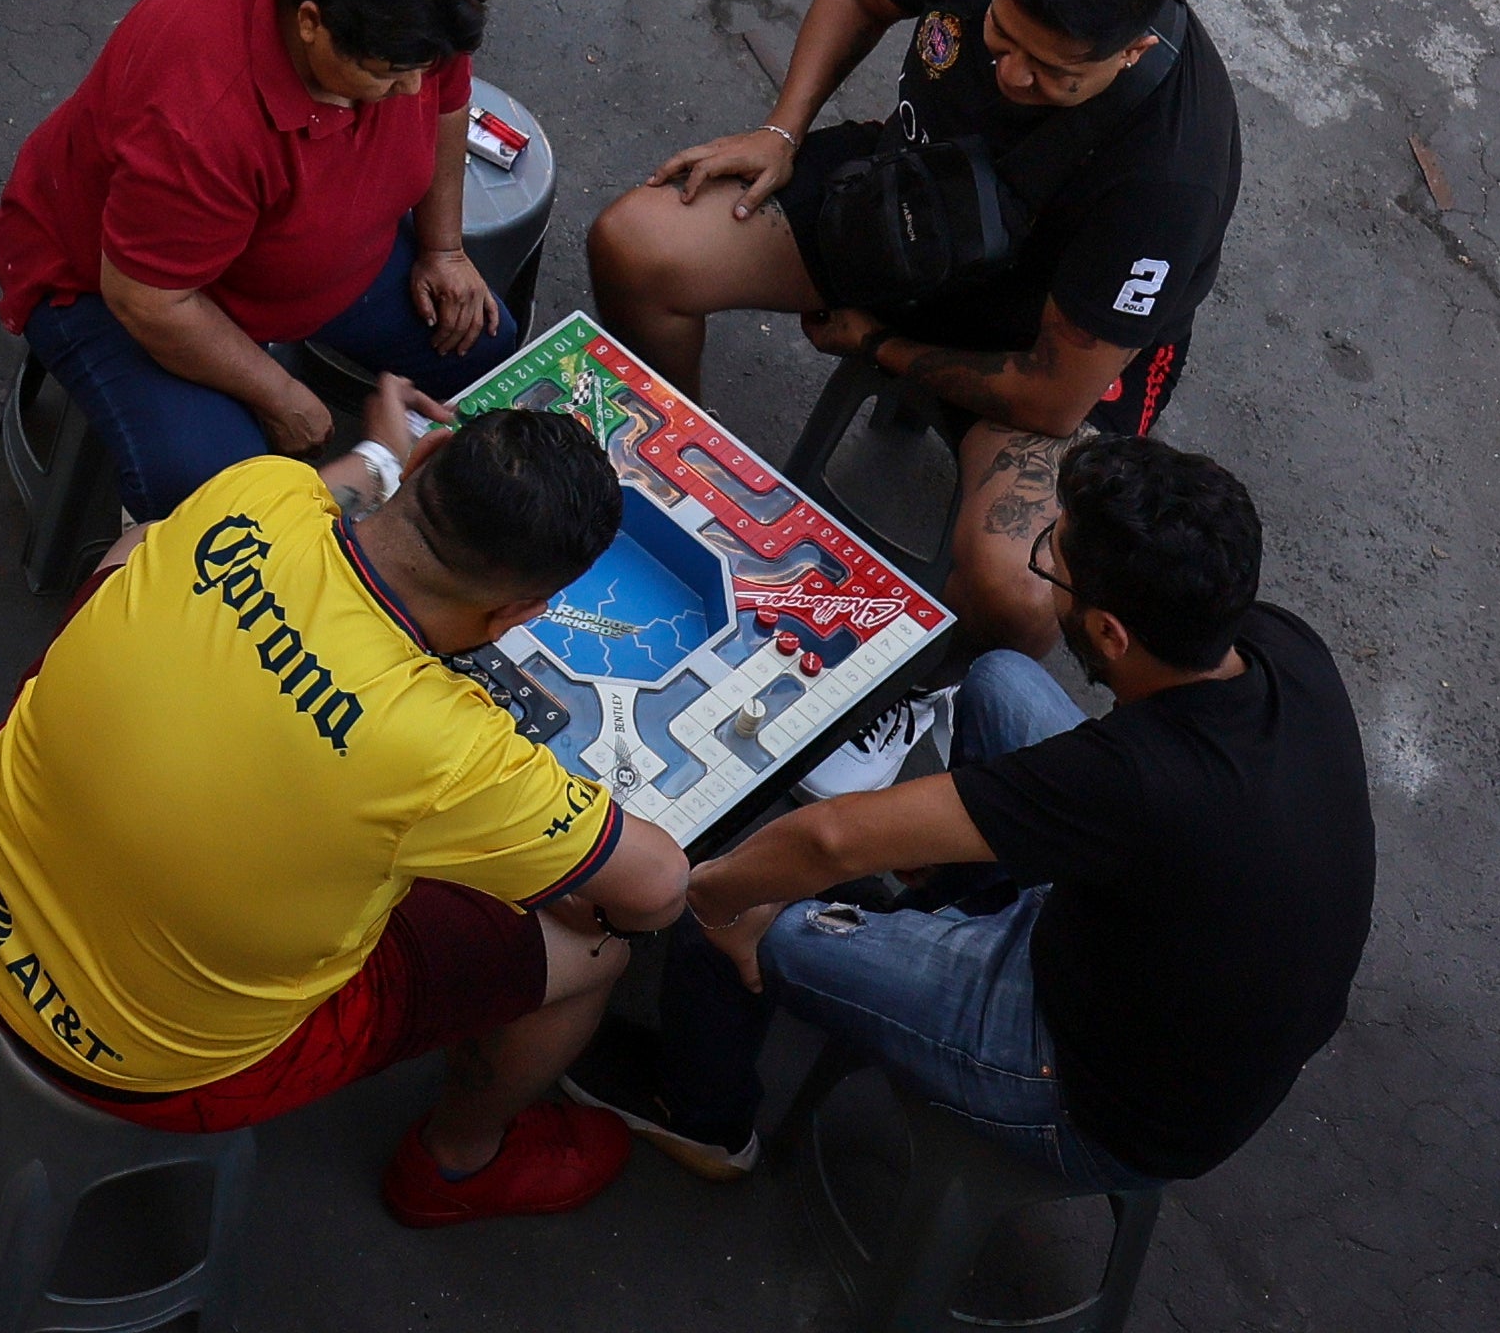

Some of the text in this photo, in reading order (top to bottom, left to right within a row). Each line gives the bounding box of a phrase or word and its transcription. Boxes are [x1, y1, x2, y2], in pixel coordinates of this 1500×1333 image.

[1113, 258, 1170, 316] 2
[1122, 302, 1145, 313] POLO
[554, 337, 572, 352] 10
[535, 351, 553, 366] 11
[514, 364, 534, 380] 12
[497, 378, 515, 392] 13
[477, 391, 497, 407] 14
[595, 345, 608, 356] 8
[616, 364, 630, 375] 7
[661, 399, 675, 410] 5
[684, 416, 696, 427] 4
[708, 436, 720, 447] 3
[731, 455, 744, 465] 2
[754, 475, 764, 483] 1
[604, 407, 614, 419] 5
[664, 433, 677, 443] 7
[674, 465, 794, 550] 5 4 3 2 1
[796, 507, 815, 525] 14
[820, 527, 839, 545] 13
[842, 546, 863, 565] 12
[866, 566, 888, 584] 11
[891, 586, 911, 604] 10
[851, 585, 866, 594] 3
[735, 582, 906, 630] Challenger
[193, 513, 364, 750] Corona
[490, 658, 503, 670] 4
[788, 717, 801, 729] 2
[808, 702, 821, 714] 3
[827, 685, 841, 697] 4
[863, 654, 876, 666] 6
[879, 638, 893, 651] 7
[898, 623, 912, 636] 8
[519, 686, 532, 697] 5
[546, 710, 559, 721] 6
[614, 692, 623, 733] BENTLEY
[526, 723, 541, 736] 7
[6, 953, 117, 1064] AT&T
